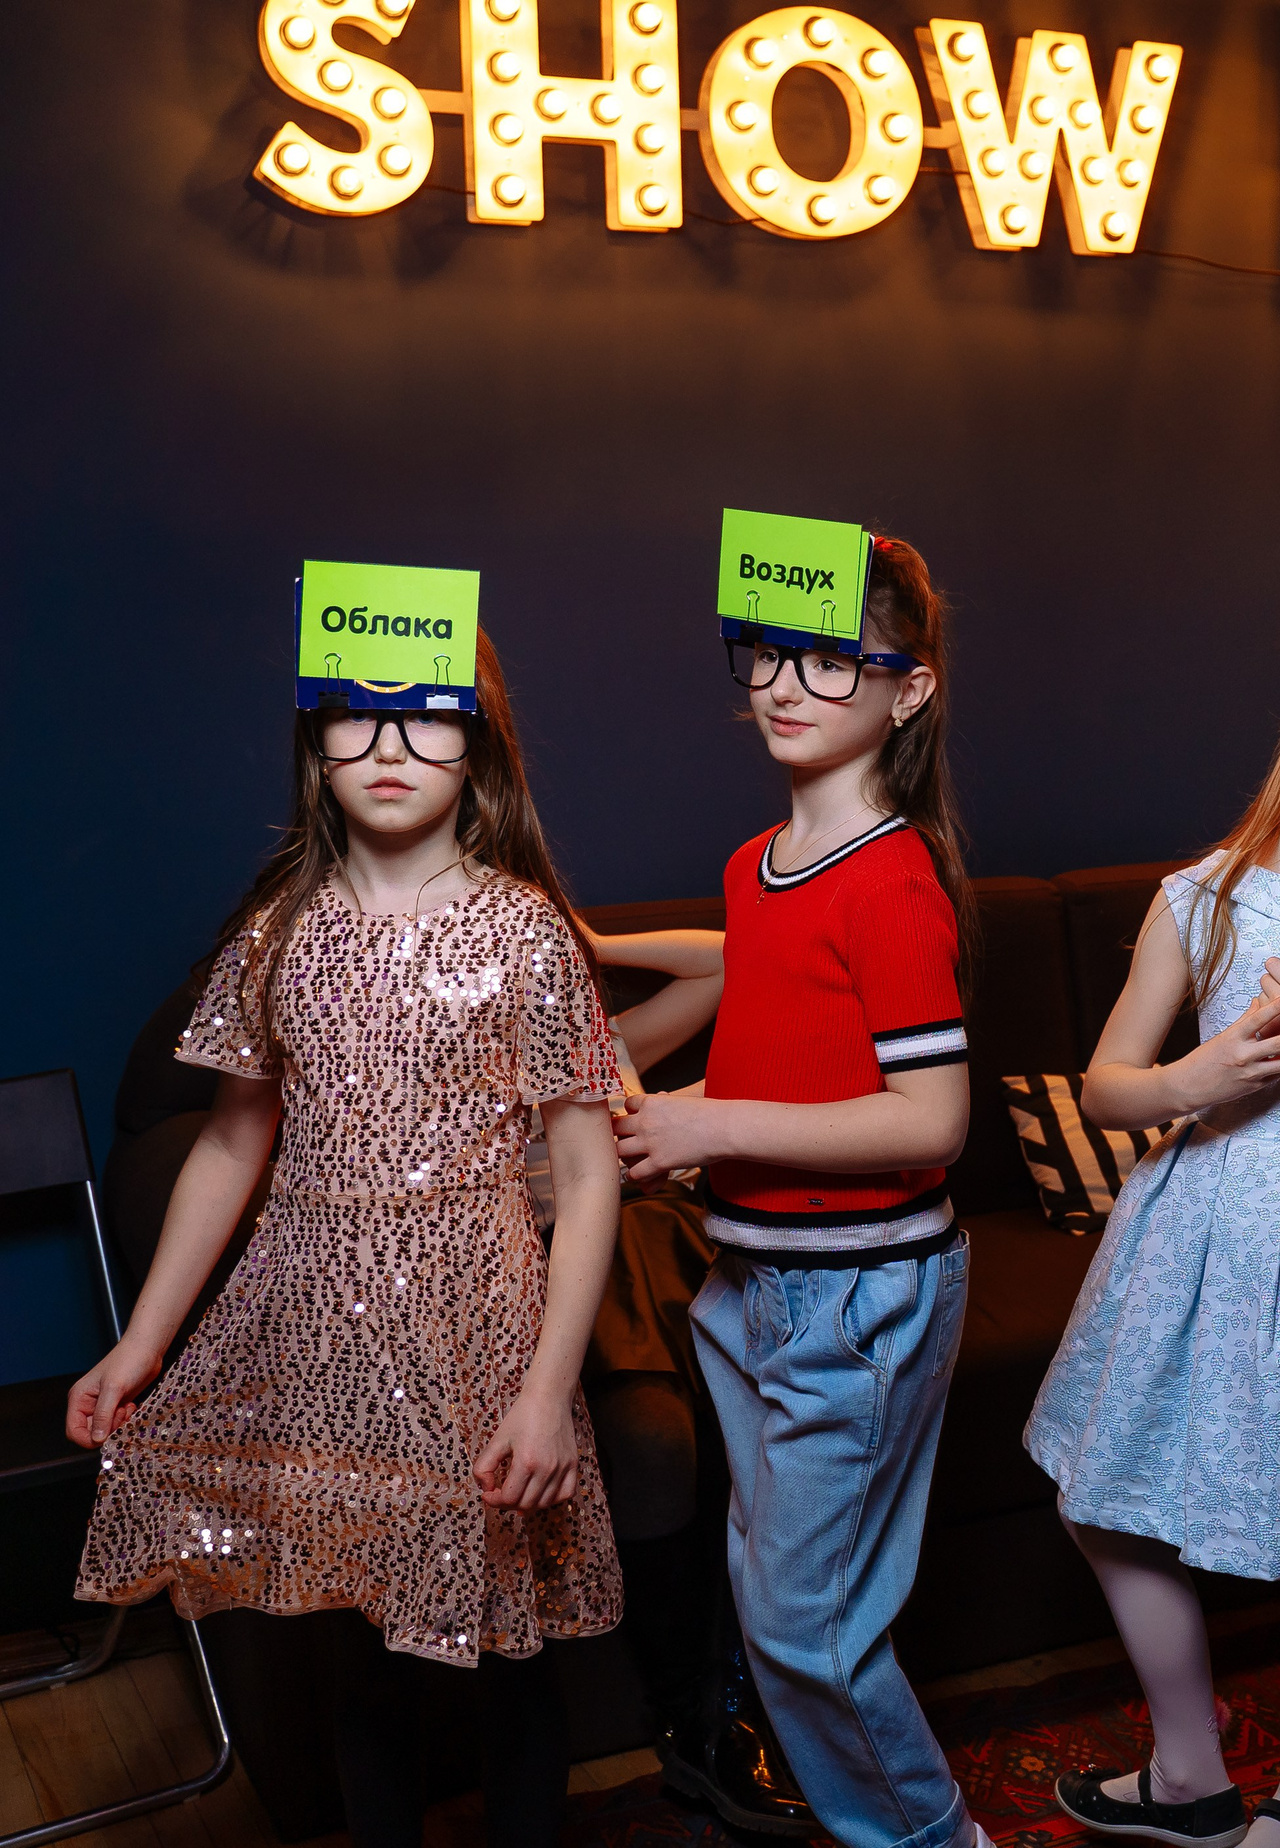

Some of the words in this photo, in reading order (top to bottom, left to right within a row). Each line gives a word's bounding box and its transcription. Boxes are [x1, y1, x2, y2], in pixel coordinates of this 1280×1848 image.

[255, 0, 1184, 256] SHOW
[738, 553, 835, 595] Воздух
[321, 605, 453, 640] Облака
